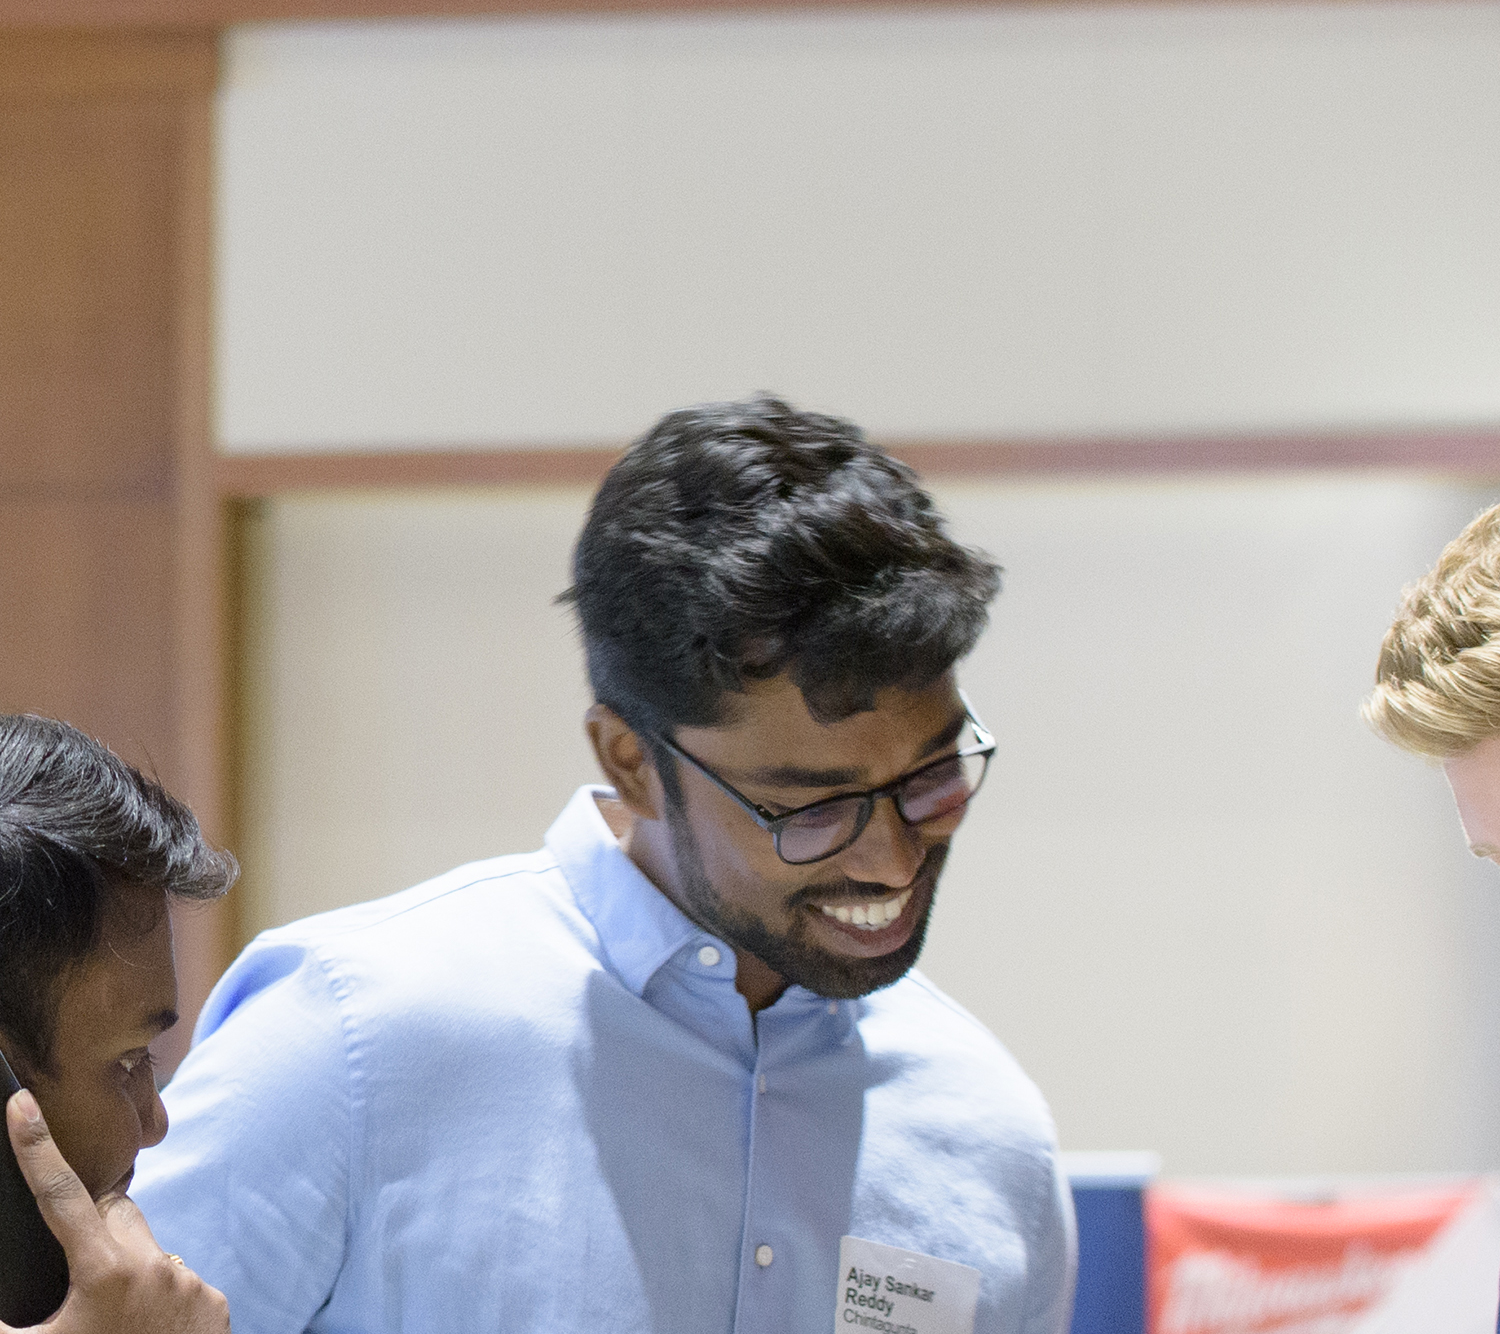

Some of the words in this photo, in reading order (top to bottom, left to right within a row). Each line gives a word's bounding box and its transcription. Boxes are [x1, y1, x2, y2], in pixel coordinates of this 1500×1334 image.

[846, 1267, 881, 1292] Ajay
[885, 1275, 935, 1303] Sankar
[845, 1287, 895, 1318] Reddy
